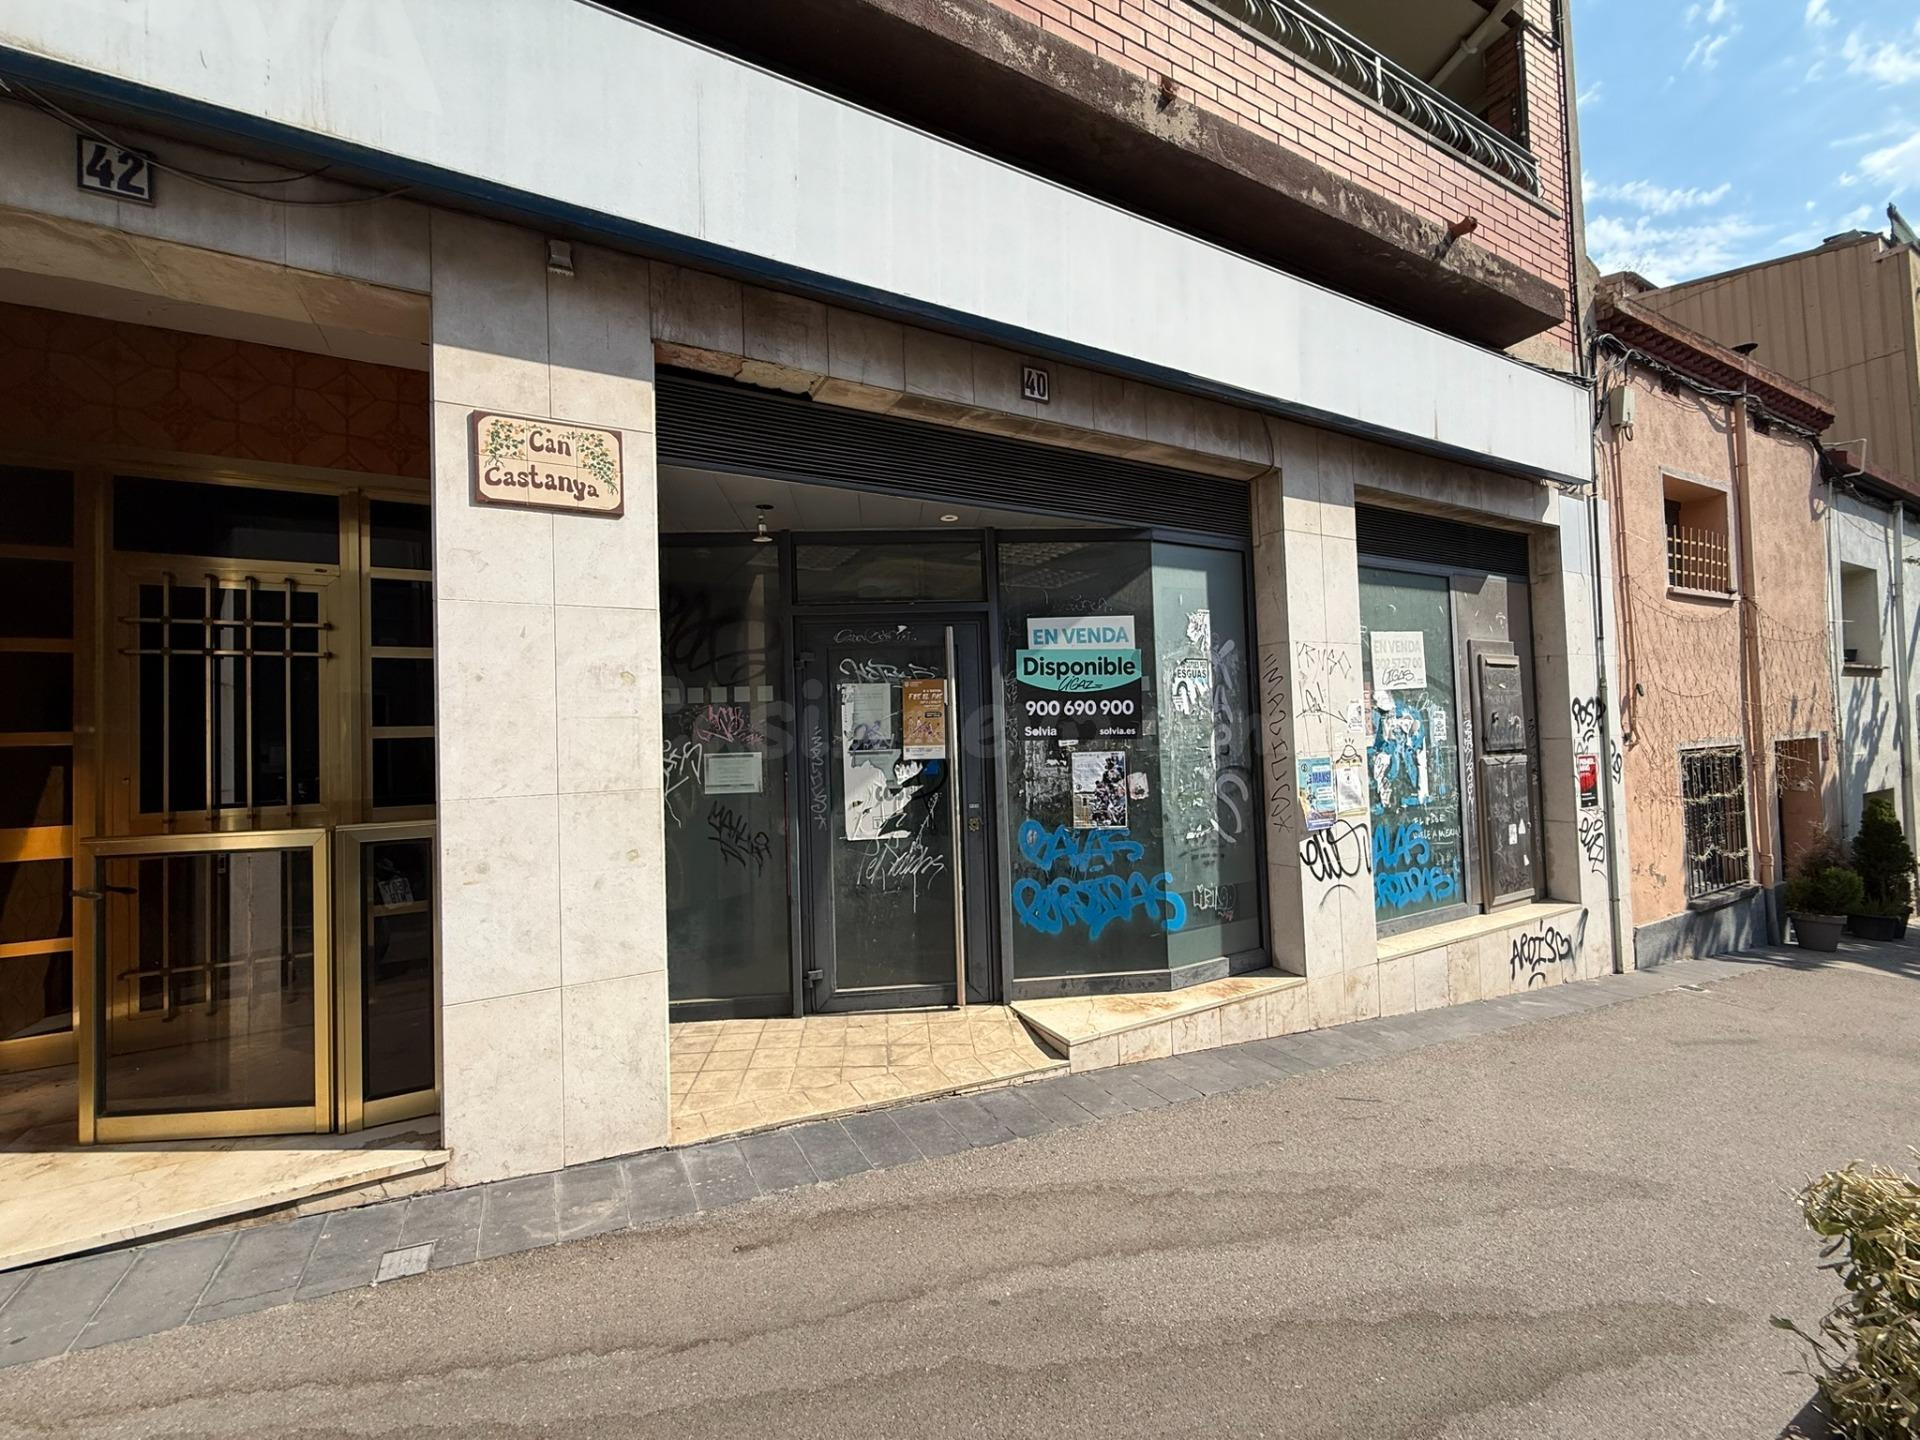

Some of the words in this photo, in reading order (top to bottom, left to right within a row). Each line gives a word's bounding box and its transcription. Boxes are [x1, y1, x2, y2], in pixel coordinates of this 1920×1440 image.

[86, 144, 145, 195] 42
[1025, 370, 1047, 398] 40
[528, 430, 572, 457] Can
[484, 464, 600, 501] Castanya
[1033, 629, 1058, 645] EN
[1061, 627, 1129, 644] VENDA
[1374, 640, 1387, 653] EN
[1388, 640, 1422, 653] VENDA
[1023, 656, 1136, 680] Disponible
[1025, 700, 1060, 716] 900
[1063, 700, 1097, 716] 690
[1100, 700, 1134, 715] 900
[1024, 726, 1057, 737] Solvia
[1099, 727, 1136, 736] solvia.es
